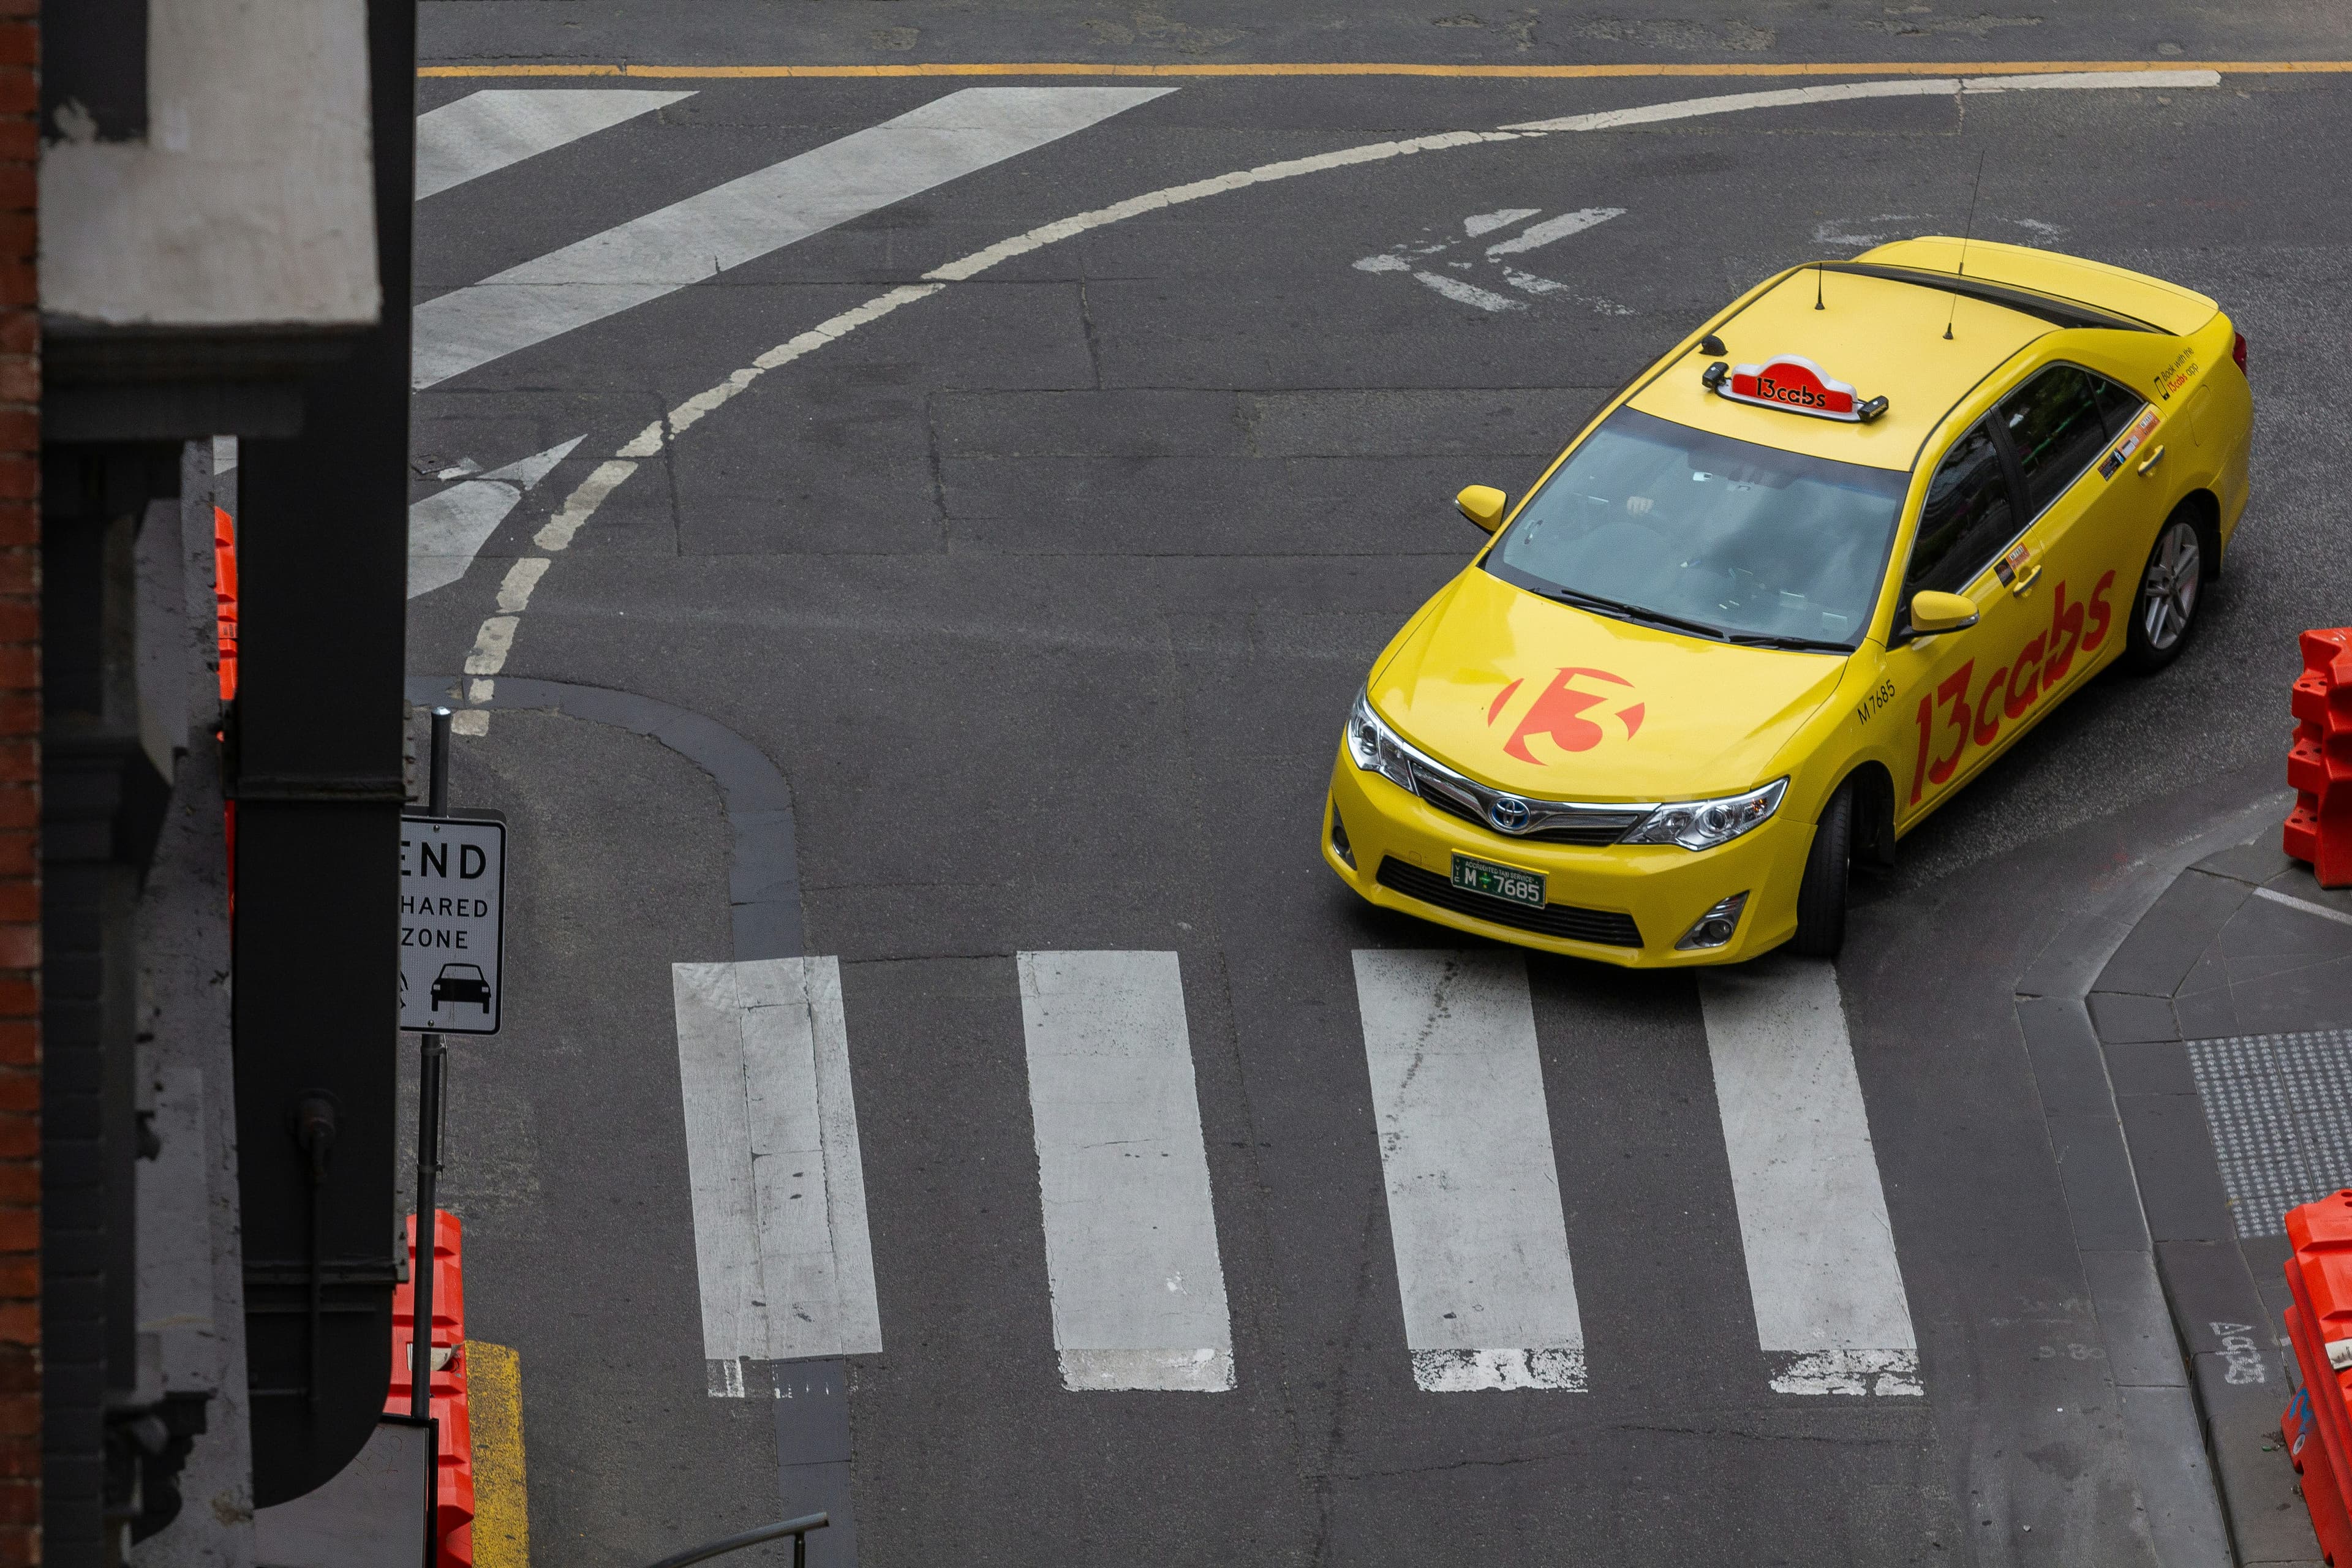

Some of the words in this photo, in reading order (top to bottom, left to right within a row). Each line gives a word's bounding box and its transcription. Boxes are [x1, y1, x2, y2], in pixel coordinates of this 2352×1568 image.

[2160, 364, 2176, 381] Book
[2174, 353, 2187, 368] with
[2183, 347, 2194, 359] the
[2167, 374, 2188, 393] 13cabs
[2185, 363, 2199, 376] app
[1757, 377, 1826, 407] 13cabs
[1857, 702, 1871, 725] M
[1869, 679, 1896, 707] 7685
[1910, 569, 2116, 807] 13cabs
[1464, 867, 1477, 887] M
[1493, 875, 1540, 902] 7685
[1510, 872, 1532, 882] SERVICE
[401, 895, 488, 918] HARED
[402, 928, 468, 949] ZONE
